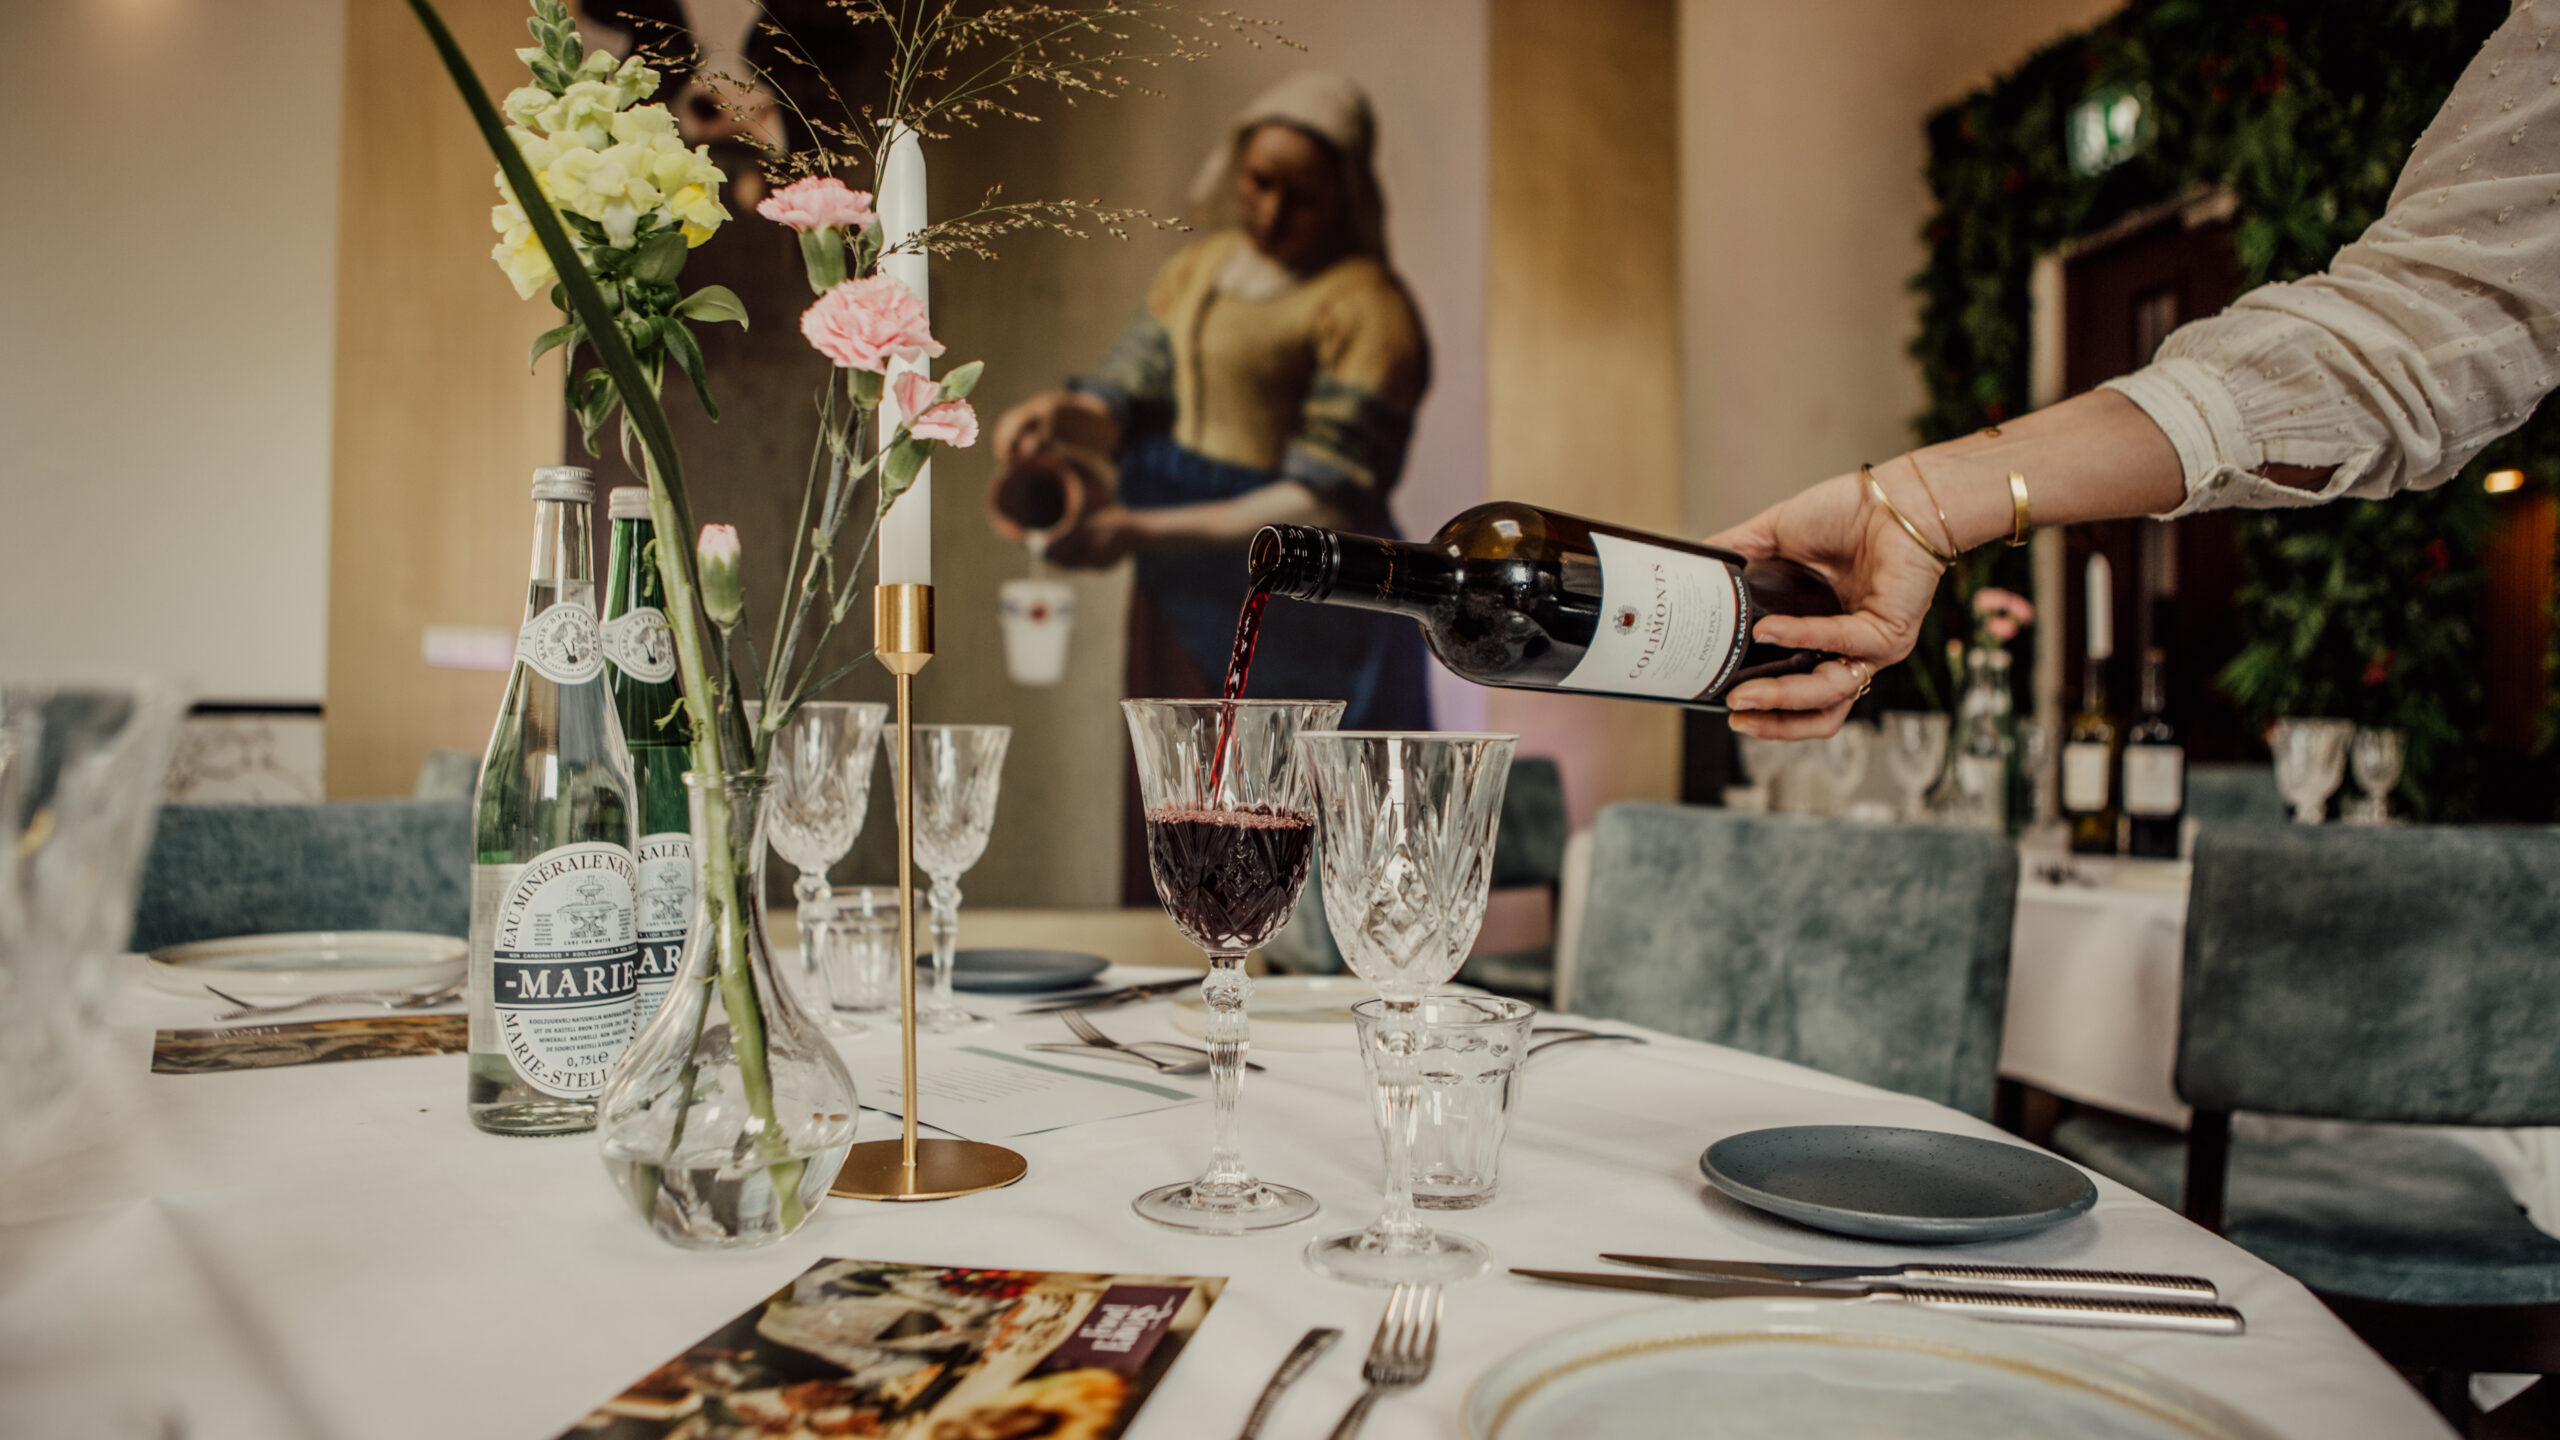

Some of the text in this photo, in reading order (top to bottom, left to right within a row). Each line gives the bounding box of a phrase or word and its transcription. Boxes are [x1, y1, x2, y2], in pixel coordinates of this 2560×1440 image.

[1629, 564, 1667, 679] COLIMONTS
[503, 911, 521, 949] EAU
[513, 854, 602, 911] MINÉRALE
[637, 844, 680, 864] RALE
